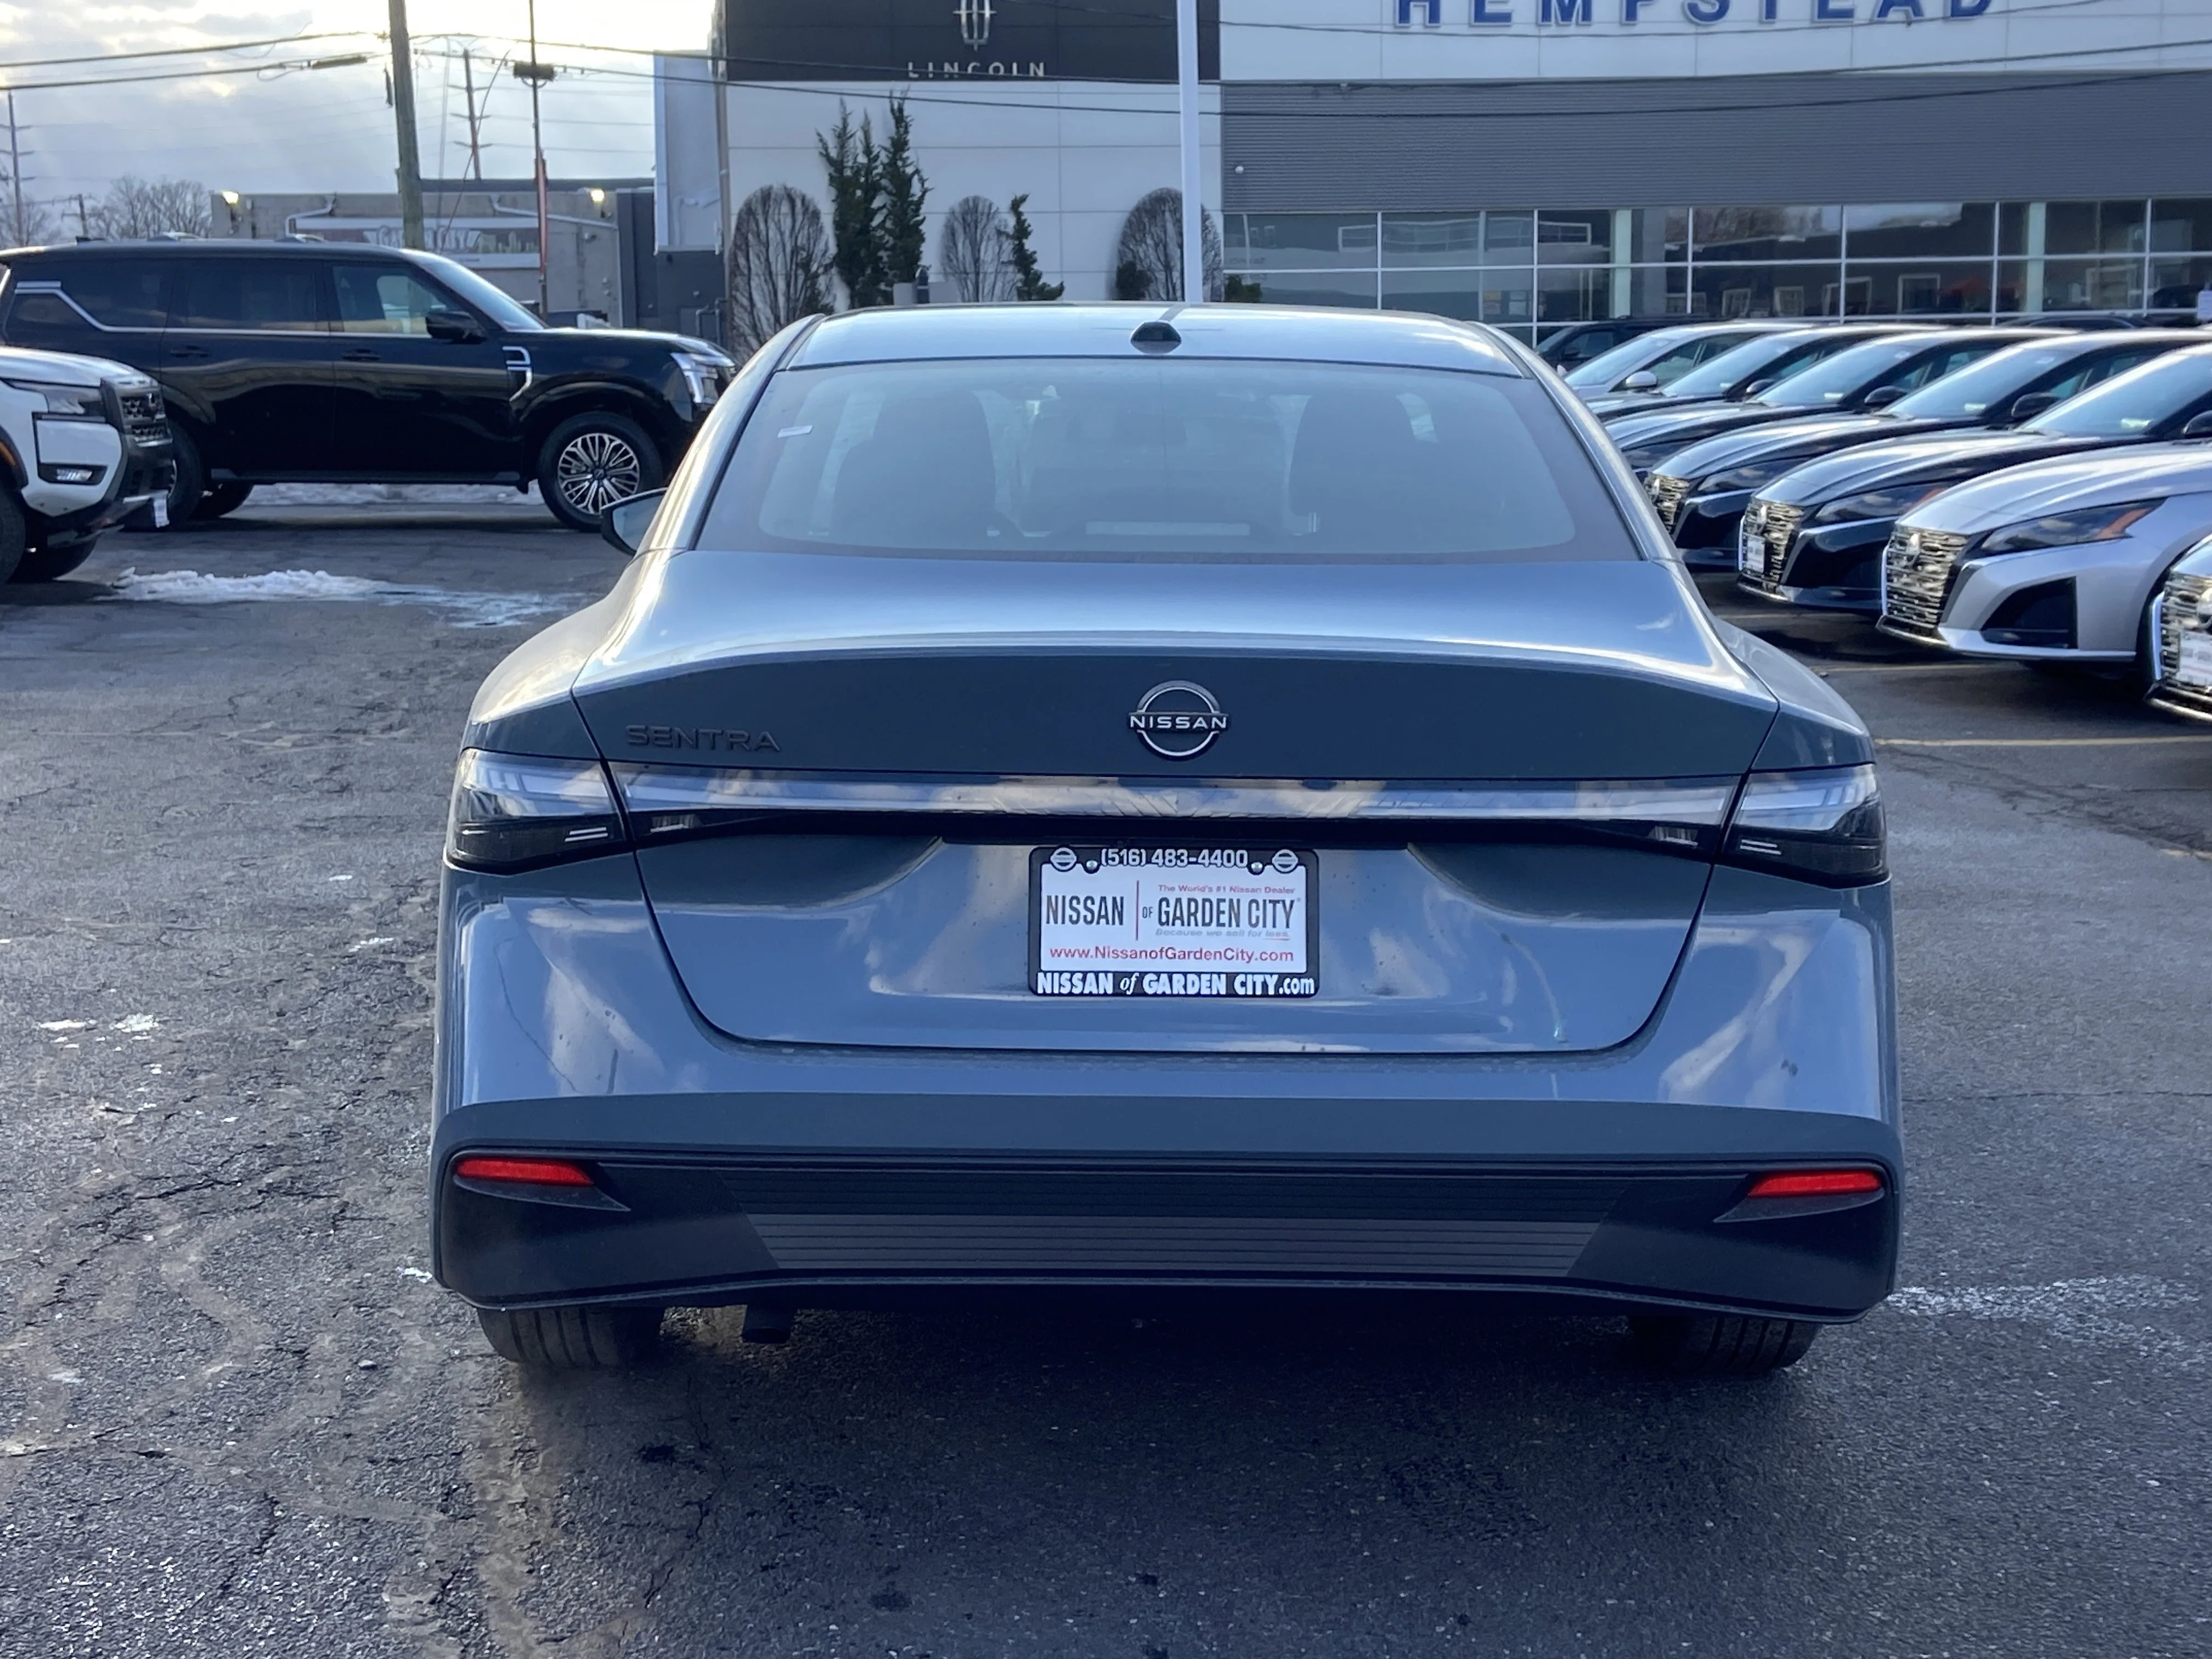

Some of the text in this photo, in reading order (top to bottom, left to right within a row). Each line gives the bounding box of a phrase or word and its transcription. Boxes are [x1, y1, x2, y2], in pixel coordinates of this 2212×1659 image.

[1130, 715, 1227, 729] NISSAN
[625, 724, 781, 752] SENTRA
[1101, 849, 1248, 868] (516) 483-4400
[1178, 884, 1213, 893] World's
[1264, 886, 1295, 894] Dealer
[1046, 895, 1295, 929] NISSAN OF GARDEN CITY
[1155, 928, 1203, 936] Because
[1248, 929, 1262, 938] for
[1050, 946, 1294, 964] www.NissanofGardenCity.com
[1037, 972, 1114, 994] NISSAN
[1120, 973, 1139, 995] of
[1142, 973, 1227, 995] GARDEN
